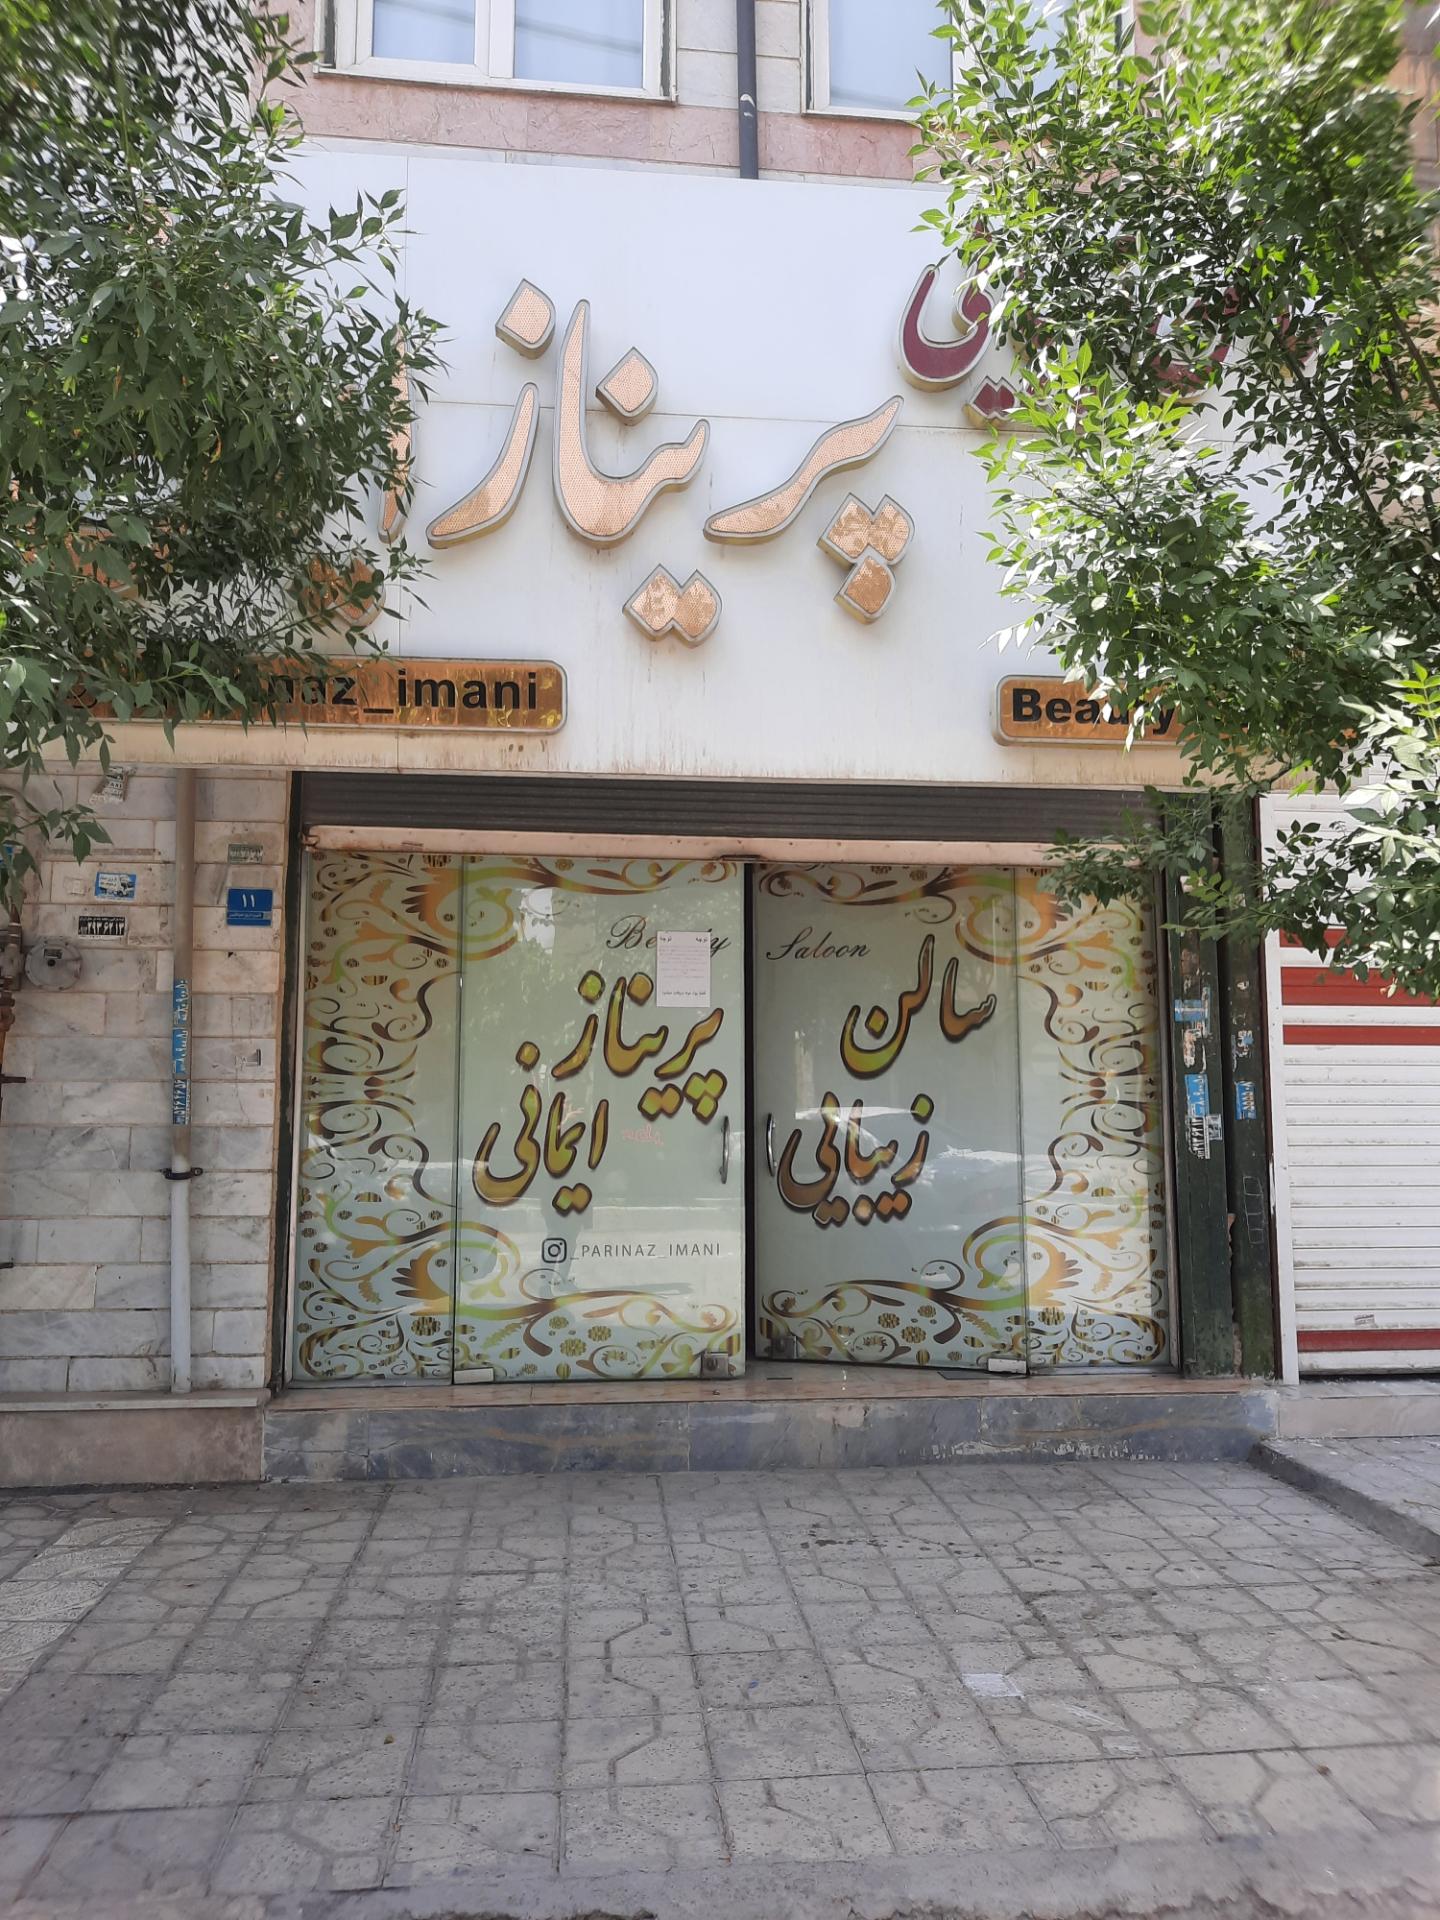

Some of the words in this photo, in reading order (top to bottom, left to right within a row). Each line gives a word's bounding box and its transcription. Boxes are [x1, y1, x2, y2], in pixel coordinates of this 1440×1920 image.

[427, 279, 915, 649] پریناز
[242, 894, 255, 908] ۱۱
[766, 927, 870, 960] Saloon
[552, 969, 728, 1122] پریناز
[840, 934, 997, 1076] سالن
[473, 1041, 610, 1213] ایمانی
[777, 1092, 934, 1227] زیبایی
